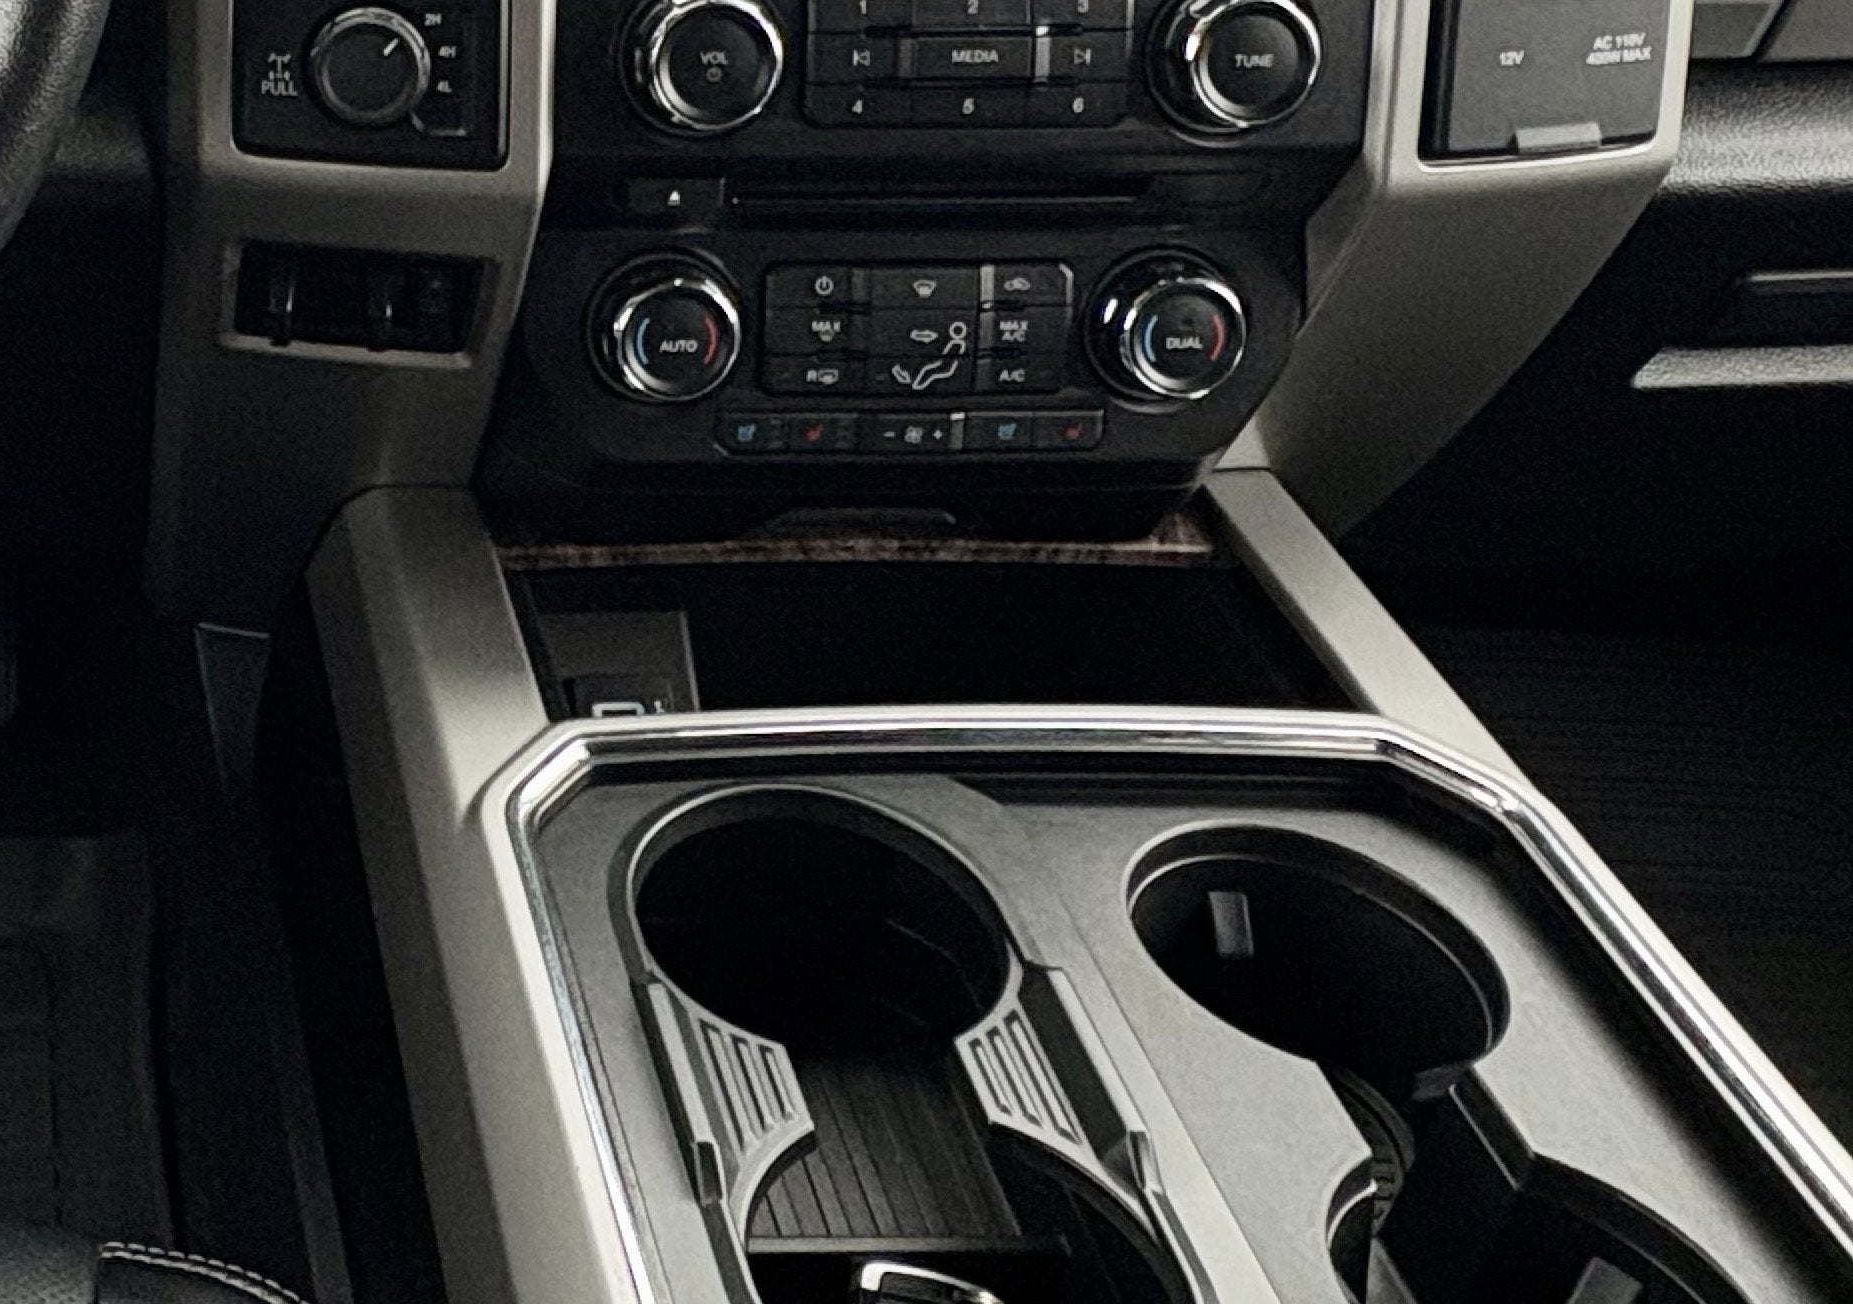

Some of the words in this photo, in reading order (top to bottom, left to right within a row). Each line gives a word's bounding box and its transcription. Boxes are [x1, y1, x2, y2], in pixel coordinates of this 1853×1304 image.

[1593, 36, 1613, 50] AC
[700, 51, 729, 66] VOL
[951, 49, 999, 64] MEDIA
[1234, 53, 1275, 69] TUNE
[1499, 50, 1525, 65] 12V
[1621, 46, 1653, 62] MAX
[261, 80, 298, 96] PULL
[851, 99, 863, 115] 4
[812, 321, 841, 333] MAX
[999, 321, 1028, 332] MAX
[1002, 331, 1026, 343] A/C
[1165, 336, 1203, 350] DUAL
[659, 339, 699, 353] AUTO
[999, 370, 1026, 383] A/C
